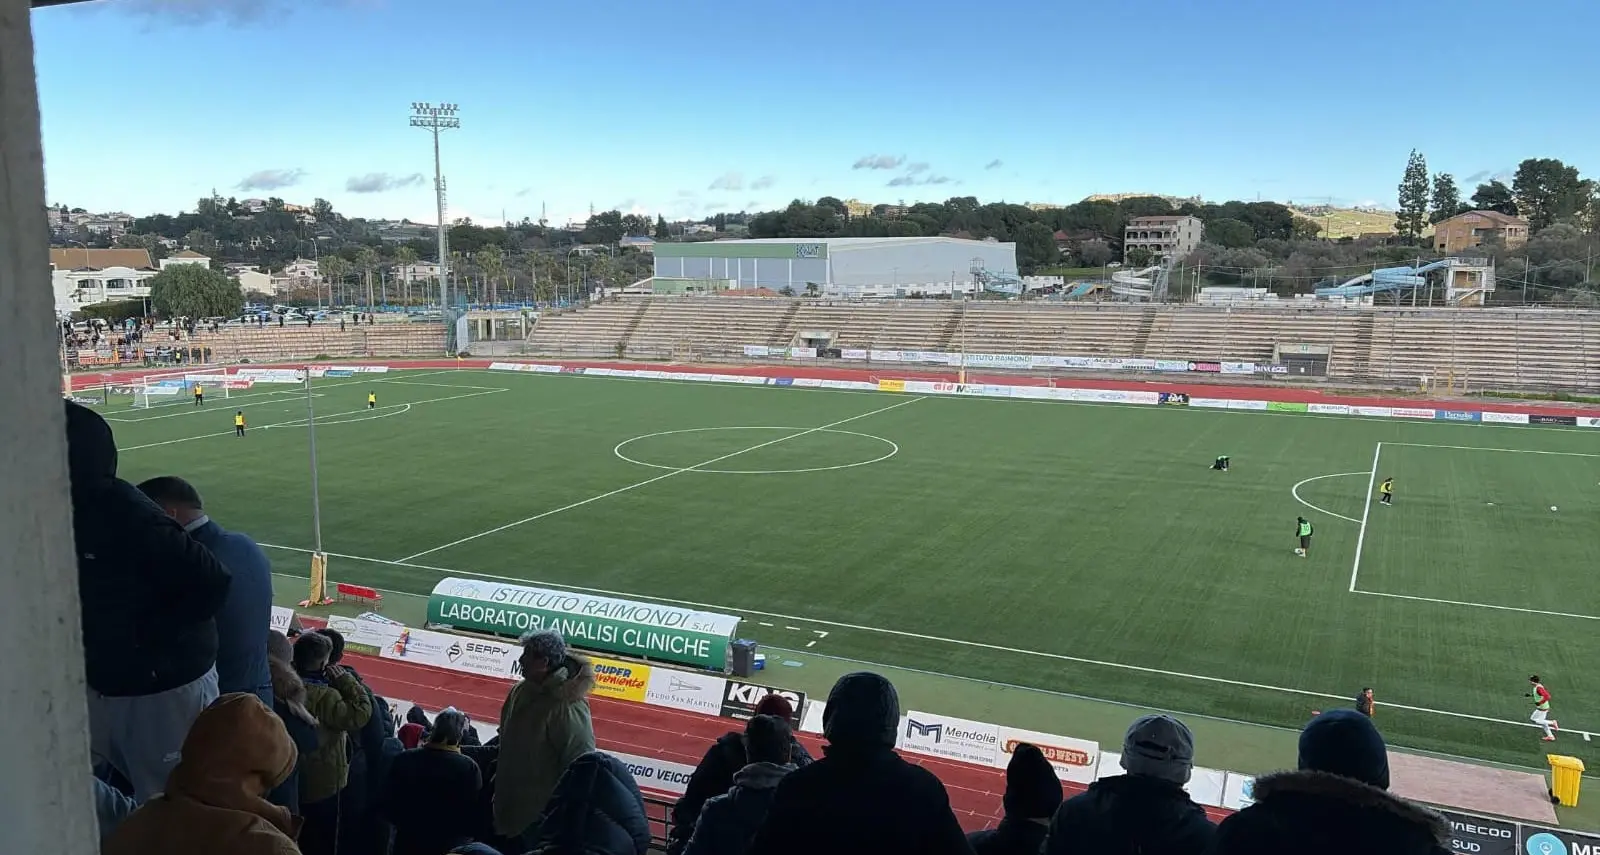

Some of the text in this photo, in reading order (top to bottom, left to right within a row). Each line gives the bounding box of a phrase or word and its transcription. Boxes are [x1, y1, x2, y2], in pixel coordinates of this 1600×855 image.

[490, 588, 579, 611] ISTITUTO
[581, 600, 690, 627] RAIMONDI
[692, 622, 716, 633] s.r.l.
[440, 601, 711, 658] LABORATORI ANALISI CLINICHE
[594, 664, 632, 678] SUPER
[594, 673, 645, 689] veniente
[686, 697, 720, 709] MARTINO
[944, 727, 996, 743] Mendolia
[1056, 750, 1085, 764] WEST
[626, 763, 692, 784] GGIO VEICO
[1452, 839, 1481, 852] SUD
